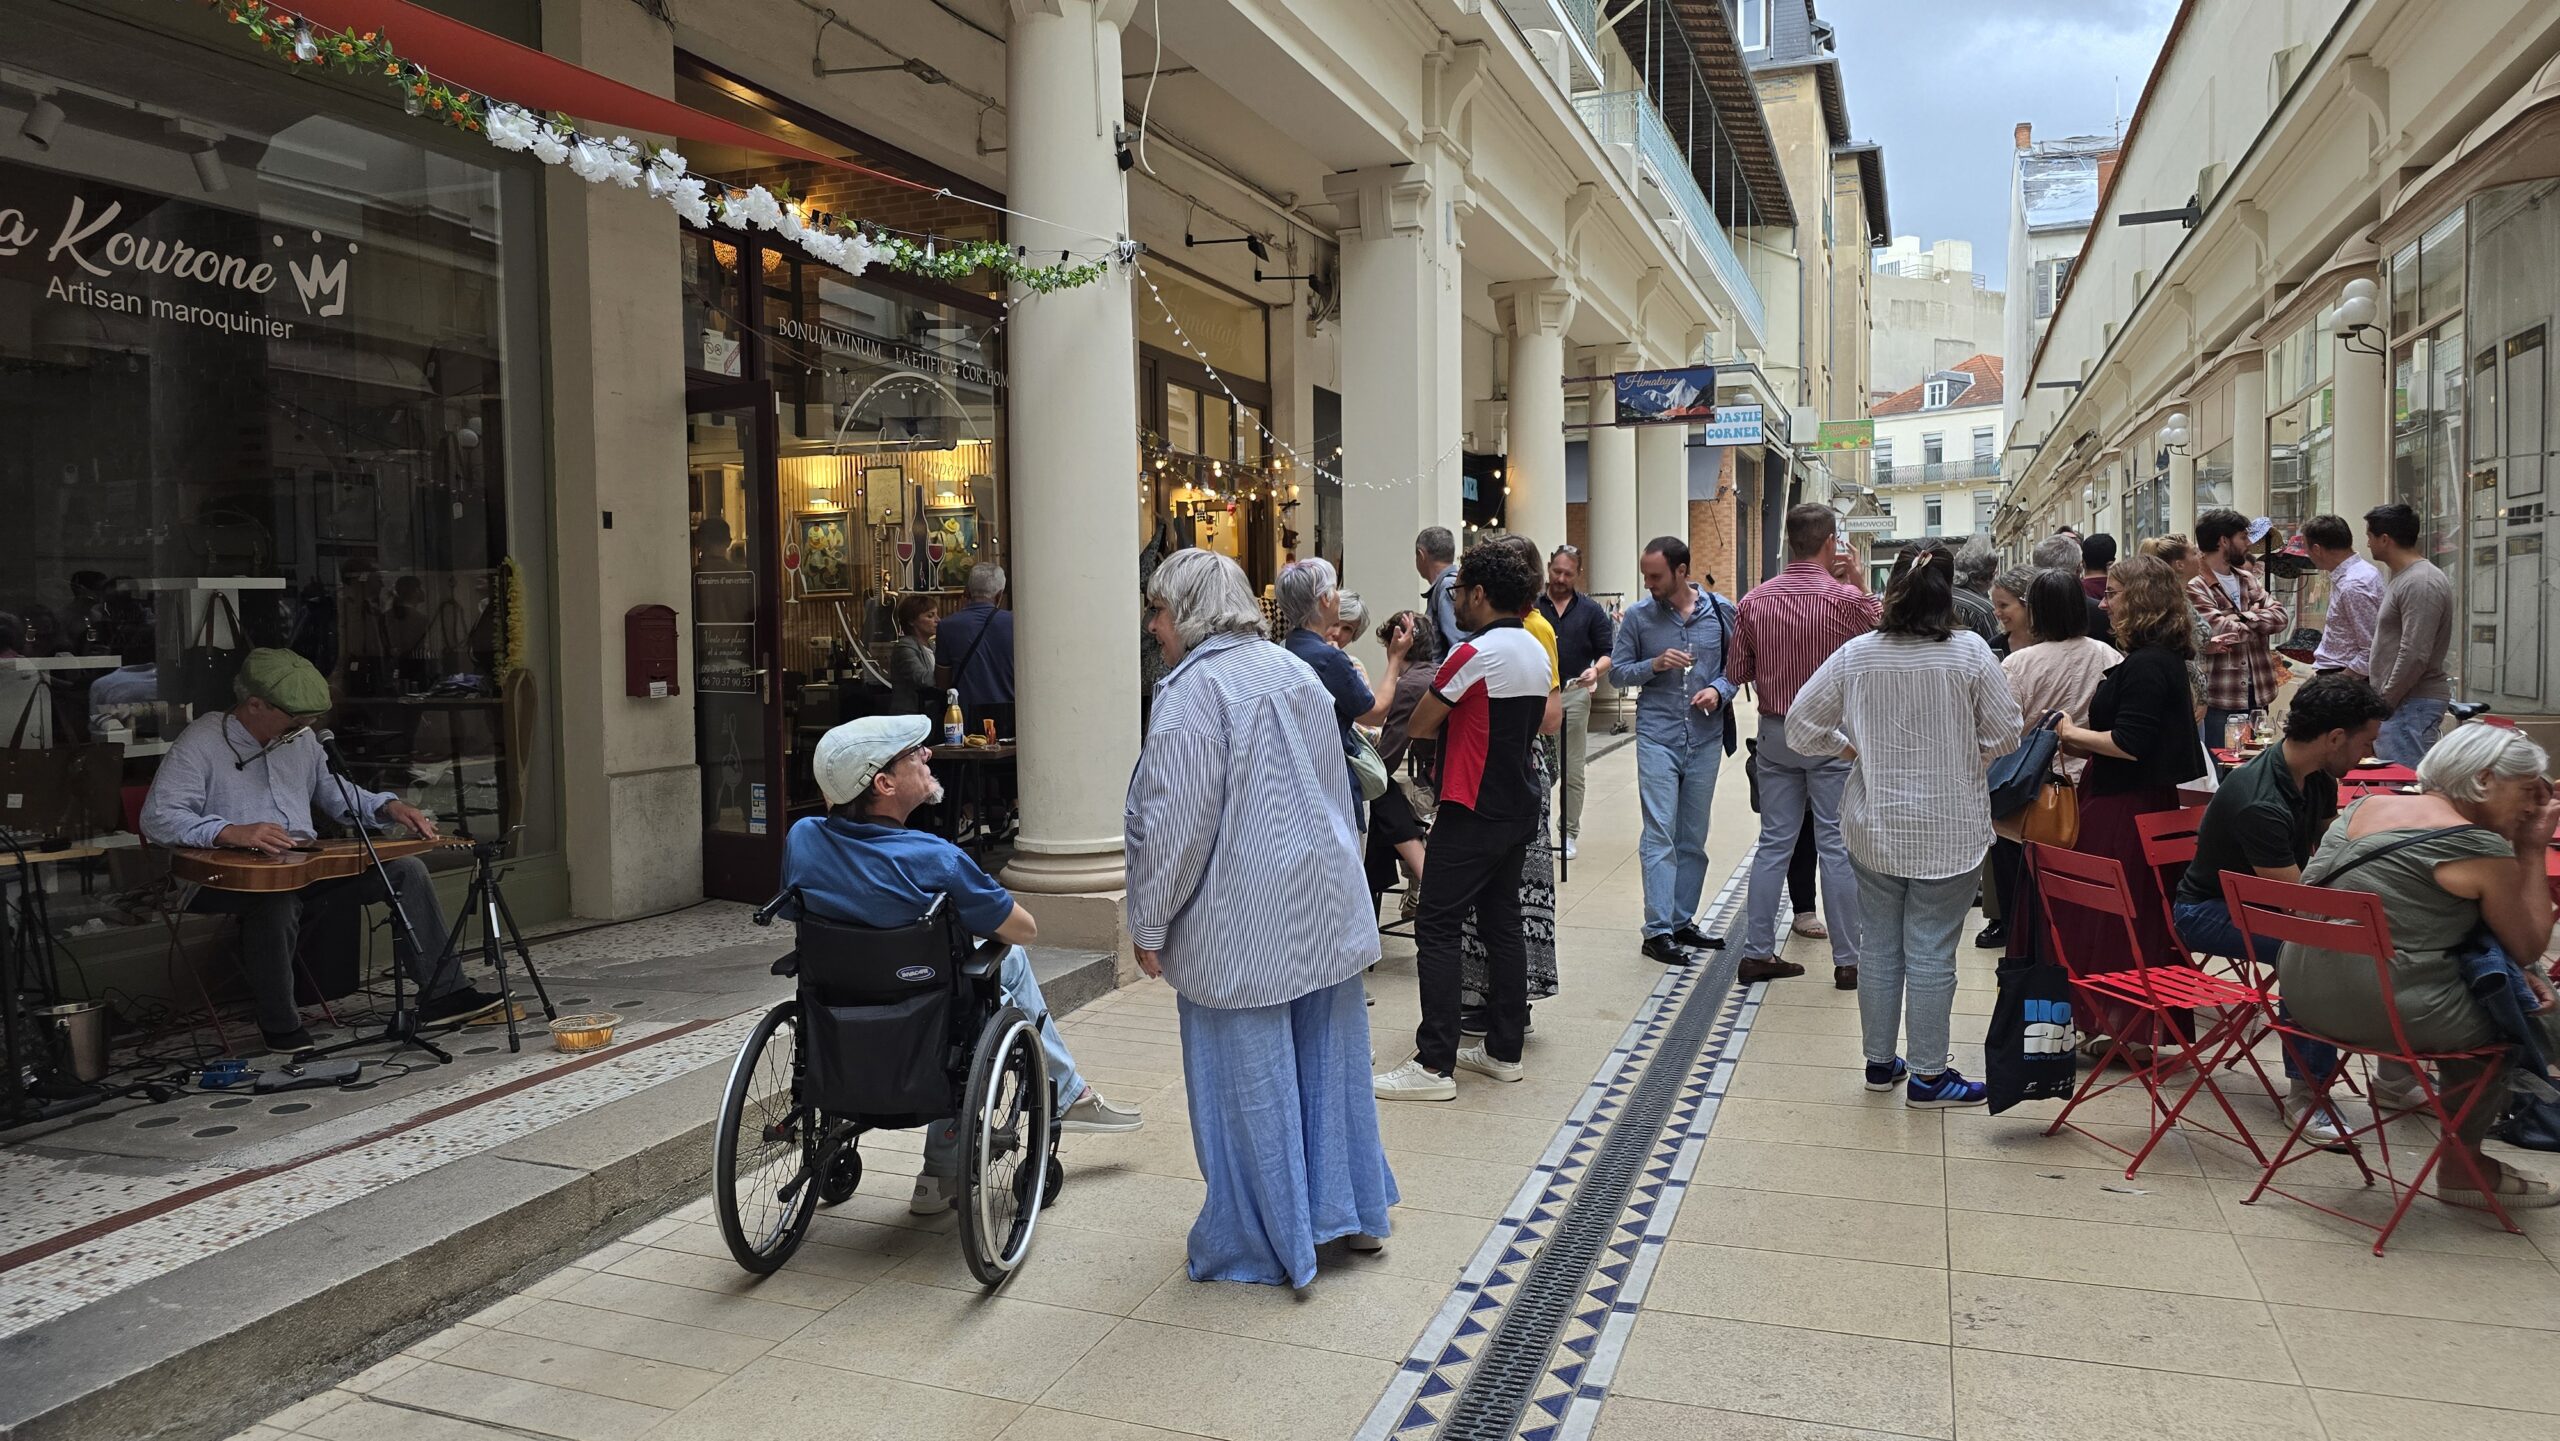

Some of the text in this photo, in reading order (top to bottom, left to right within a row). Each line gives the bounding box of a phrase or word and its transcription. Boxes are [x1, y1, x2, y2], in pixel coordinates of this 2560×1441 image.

[0, 195, 277, 294] a Kourone
[46, 276, 294, 340] Artisan maroquinier
[778, 317, 832, 347] BONUM
[836, 331, 882, 360] VINUM
[962, 364, 983, 384] COR
[1618, 373, 1678, 391] Himalaya
[1715, 411, 1762, 424] OASTIE
[1707, 427, 1761, 440] CORNER
[1847, 520, 1894, 529] IMMOWOOD
[711, 677, 721, 687] 70
[742, 678, 751, 688] 55
